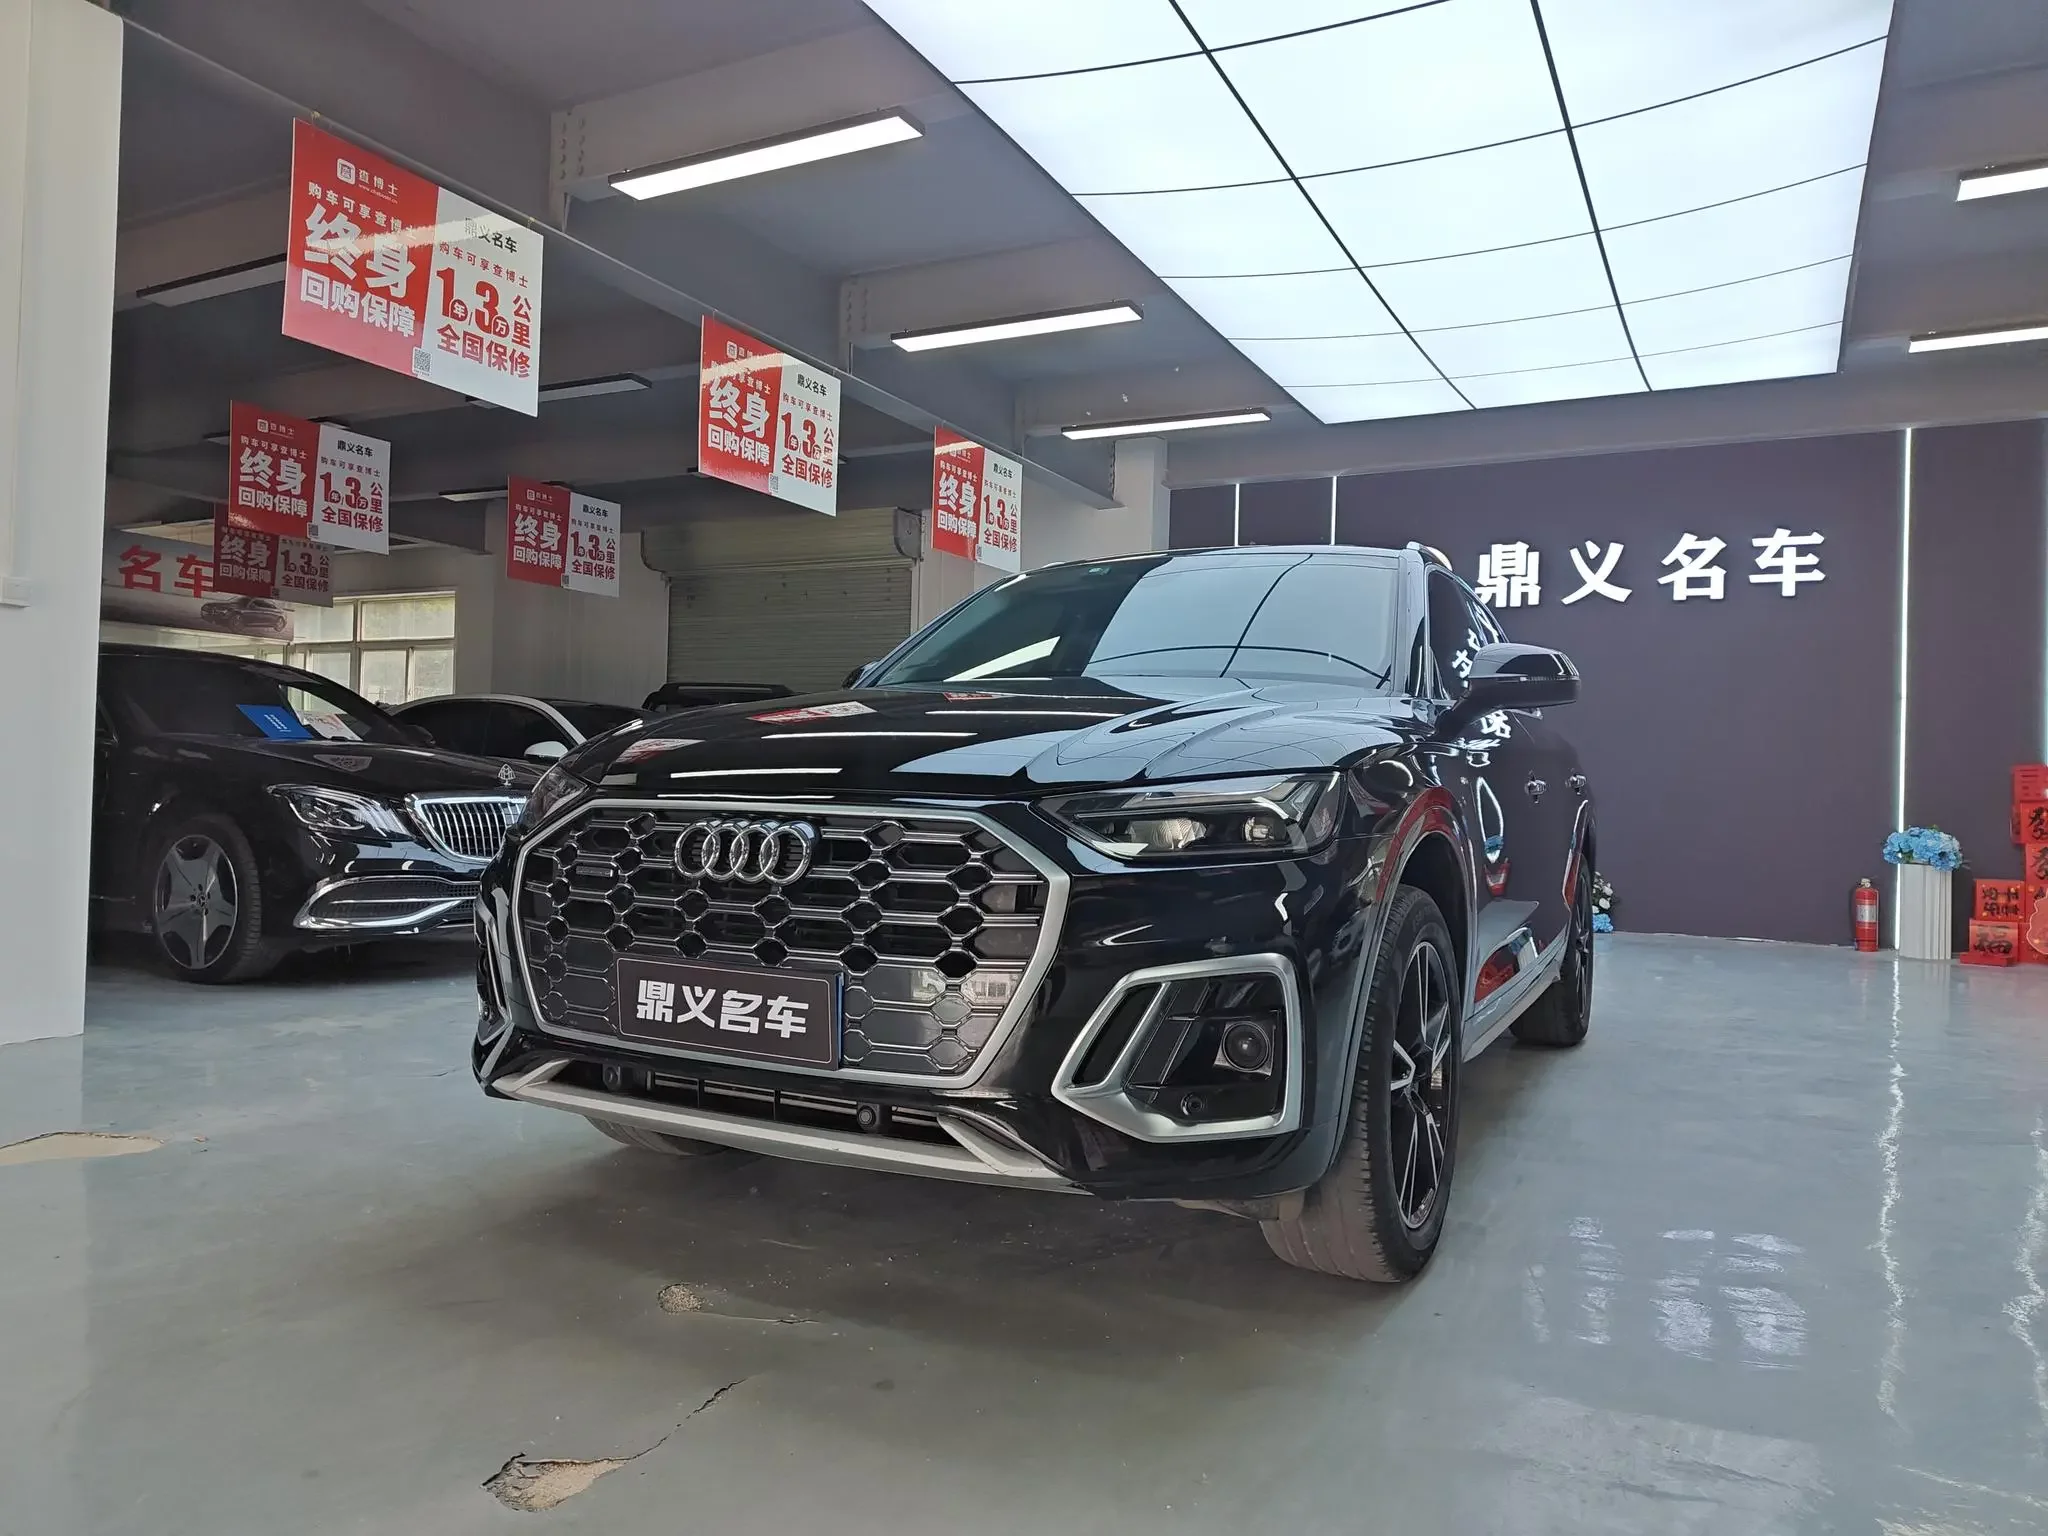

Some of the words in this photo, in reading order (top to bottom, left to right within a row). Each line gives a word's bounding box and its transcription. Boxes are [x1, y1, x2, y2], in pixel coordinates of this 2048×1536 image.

[304, 203, 416, 298] 终身
[439, 241, 529, 288] 购车可享查博士
[300, 268, 416, 337] 回购保障
[437, 323, 530, 378] 全国保修
[797, 373, 827, 396] 鼎义名车
[709, 376, 769, 438] 终身
[240, 435, 308, 460] 购车可享查博士
[337, 440, 373, 457] 鼎义名车
[707, 424, 770, 467] 回购保障
[239, 448, 306, 496] 终身
[782, 454, 833, 488] 全国保修
[238, 486, 308, 519] 回购保障
[938, 472, 976, 518] 终身
[321, 506, 383, 533] 全国保修
[514, 513, 561, 551] 终身
[937, 509, 977, 538] 回购保障
[221, 535, 271, 568] 终身
[513, 545, 562, 570] 回购保障
[983, 528, 1017, 552] 全国保修
[119, 545, 214, 598] 名车
[282, 574, 329, 593] 全国保修
[571, 559, 615, 580] 全国保修
[1475, 528, 1827, 608] 鼎义名车
[637, 980, 809, 1038] 鼎义名车
